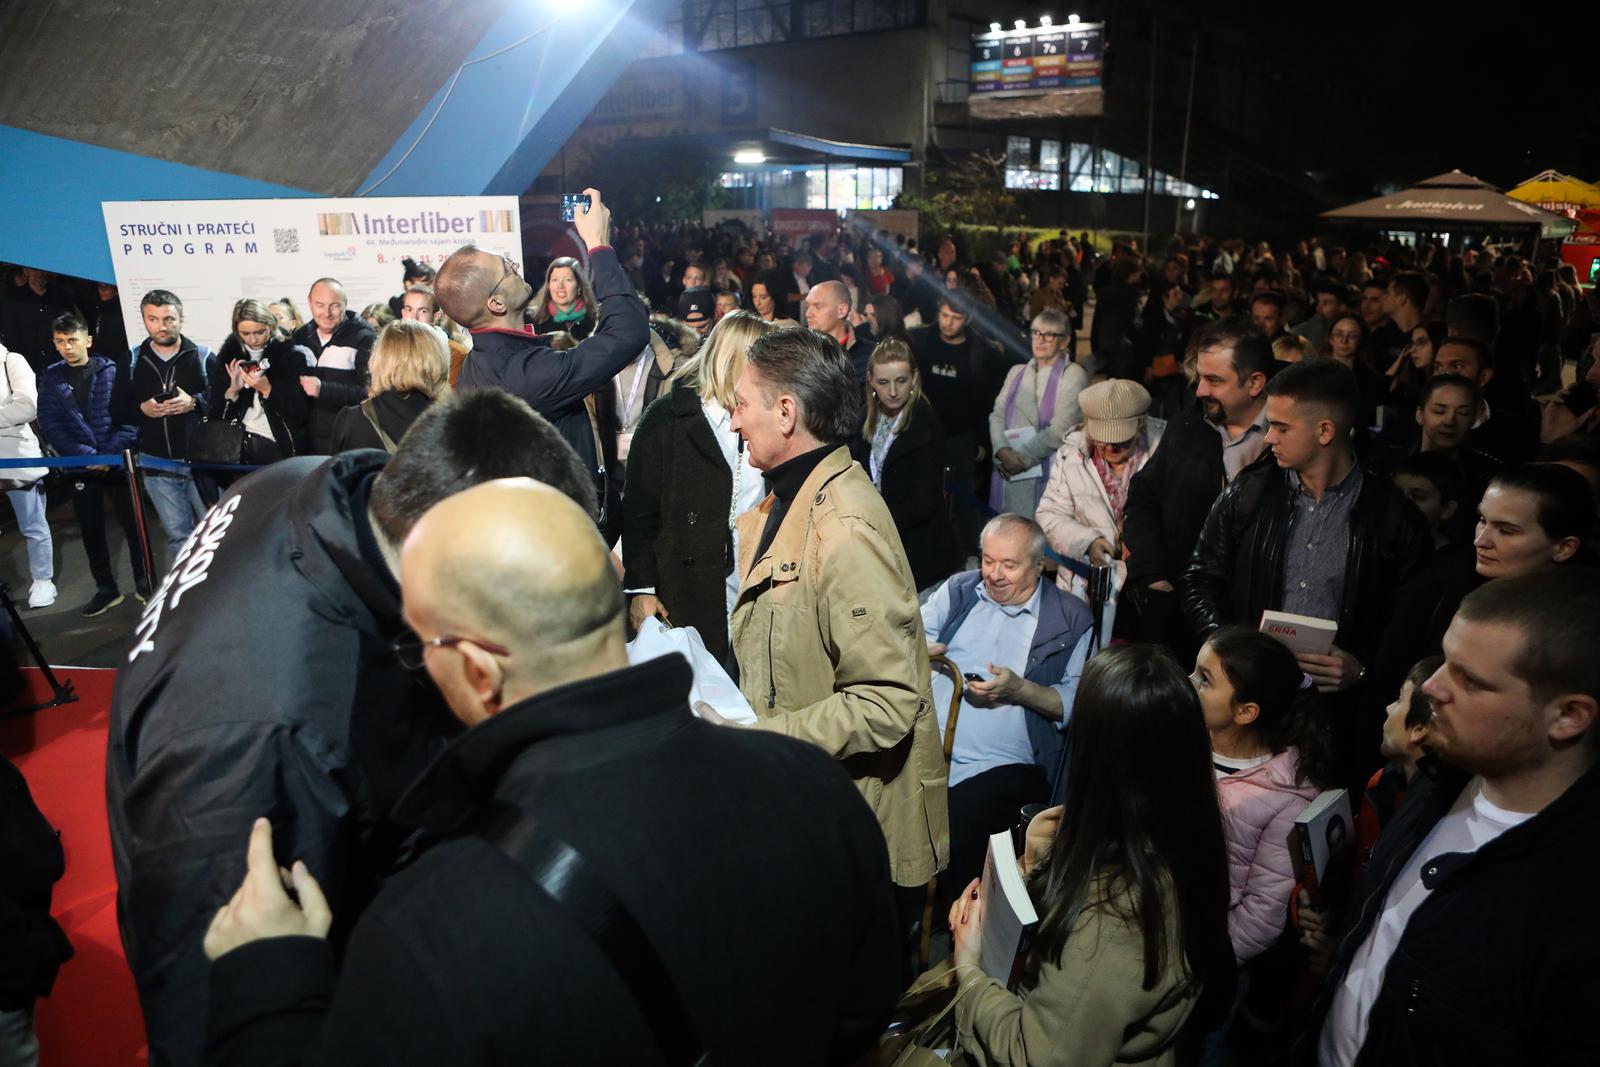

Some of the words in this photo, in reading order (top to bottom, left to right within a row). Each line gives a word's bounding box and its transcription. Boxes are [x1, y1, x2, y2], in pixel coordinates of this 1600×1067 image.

[1080, 40, 1089, 51] 7
[120, 221, 182, 236] STRUČNI
[187, 224, 192, 235] I
[197, 220, 255, 235] PRATEĆI
[364, 211, 475, 236] Interliber
[123, 242, 258, 256] PROGRAM
[377, 253, 388, 263] 8.
